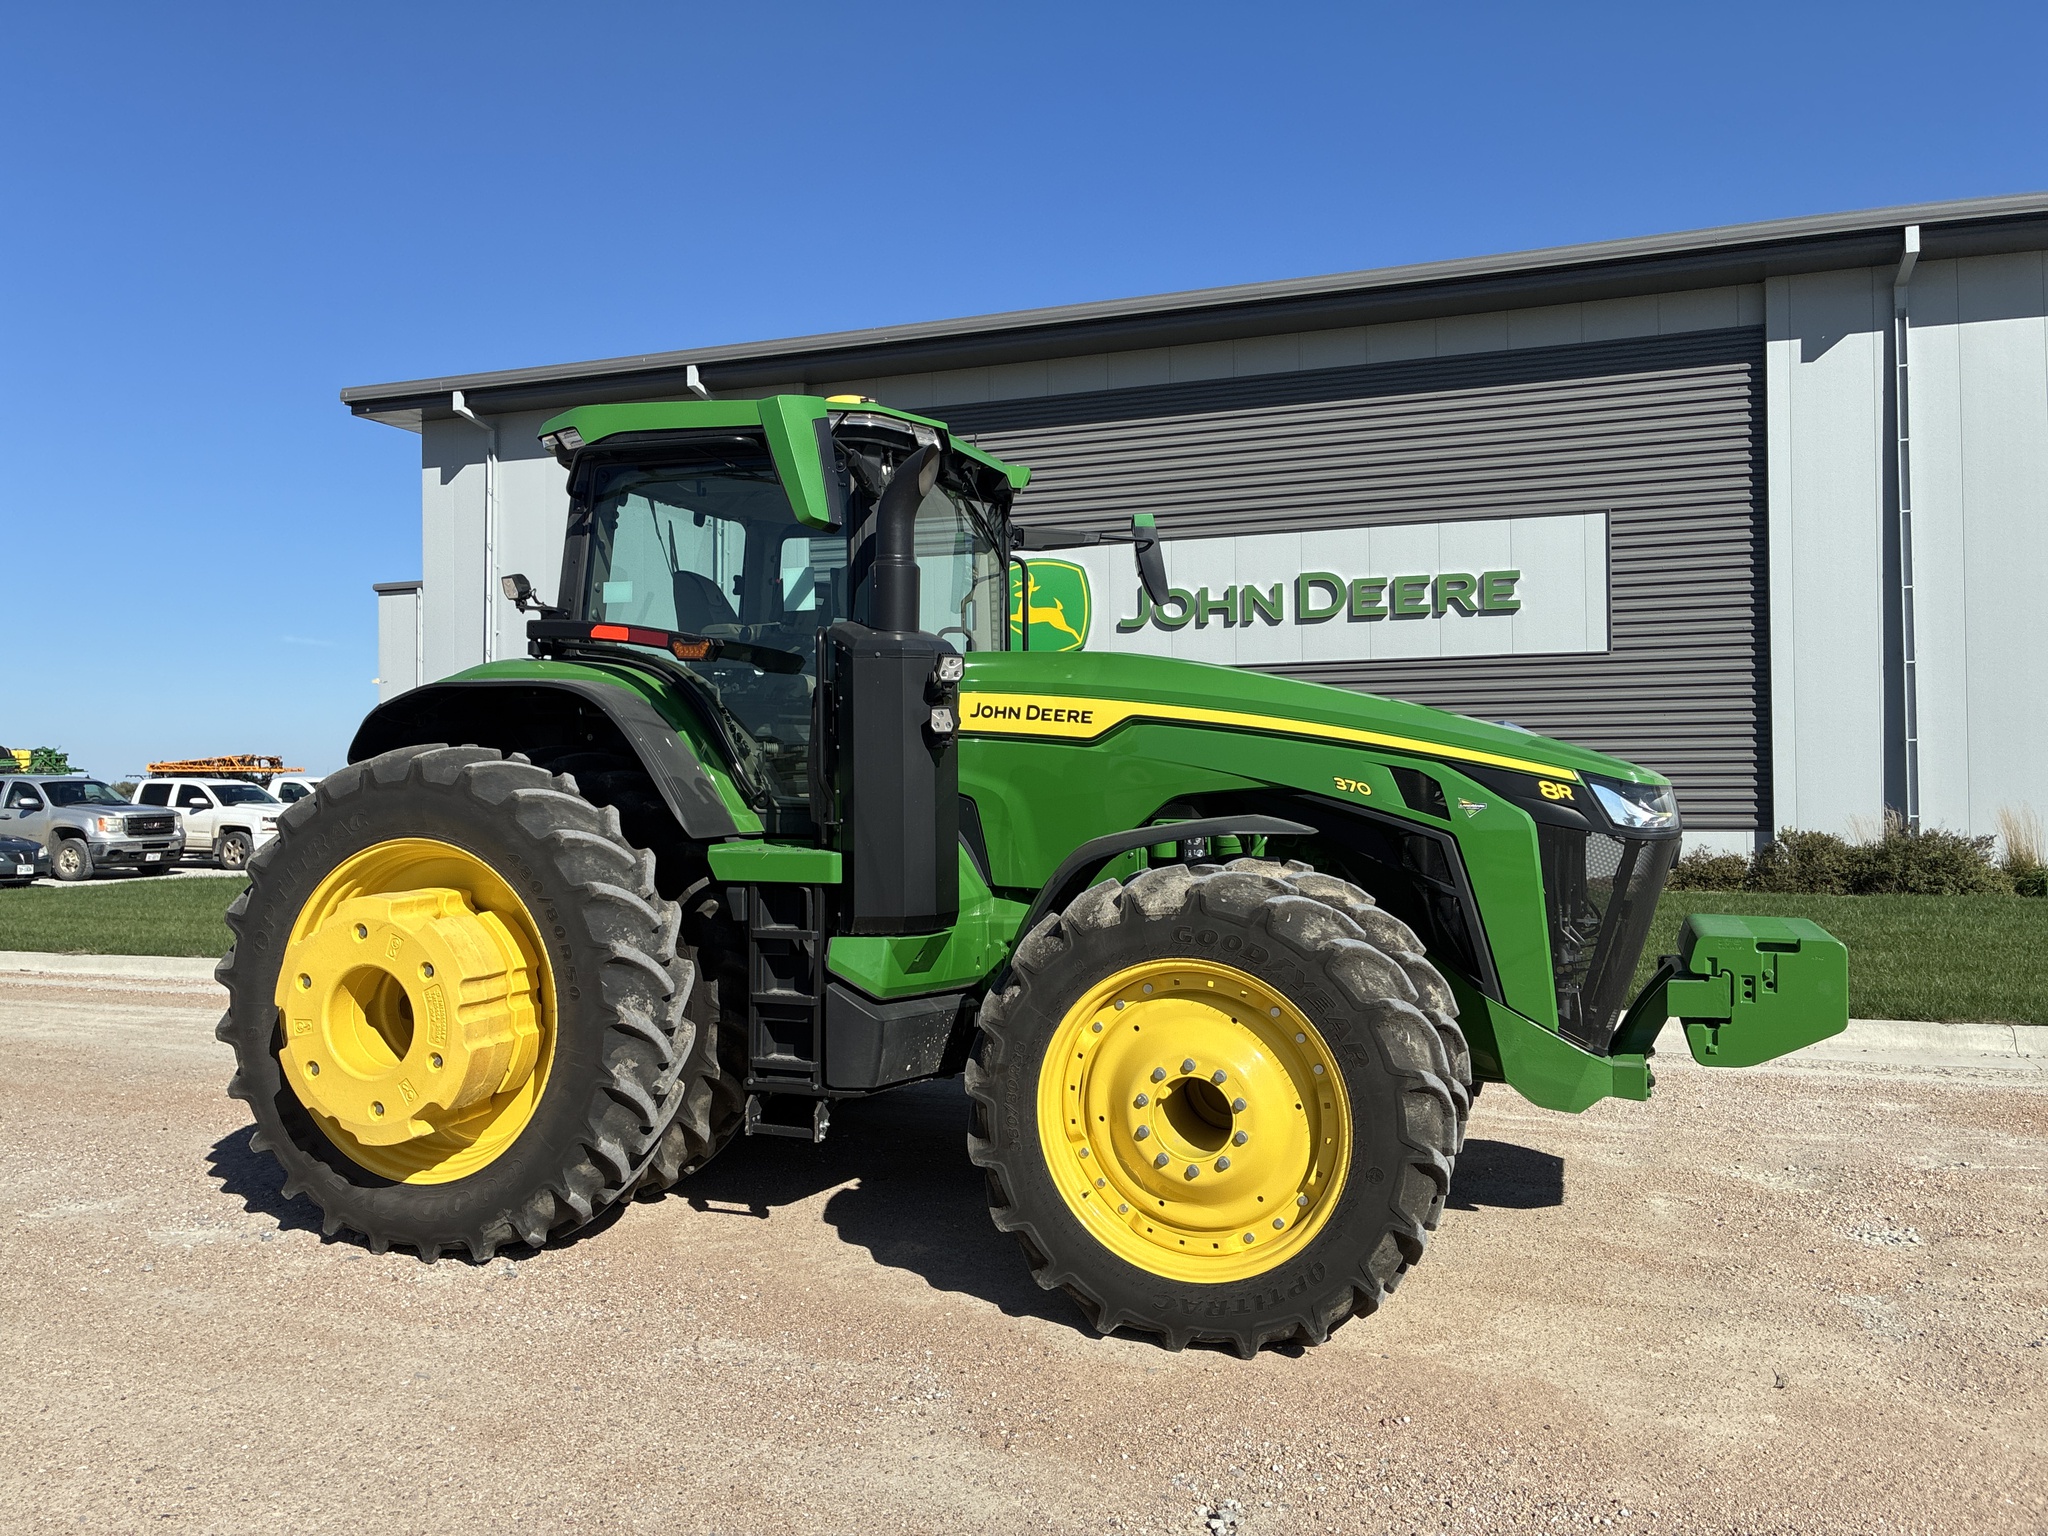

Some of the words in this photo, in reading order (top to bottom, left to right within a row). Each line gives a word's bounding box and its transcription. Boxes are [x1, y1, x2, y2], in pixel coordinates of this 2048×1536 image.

[1118, 583, 1284, 630] JOHN
[1298, 570, 1520, 621] DEERE
[970, 702, 1021, 720] JOHN
[1026, 704, 1093, 724] DEERE
[1333, 777, 1373, 797] 370
[1537, 780, 1575, 801] 8R
[1168, 925, 1371, 1073] GOODYEAR
[1151, 1255, 1328, 1319] OPTITRAC
